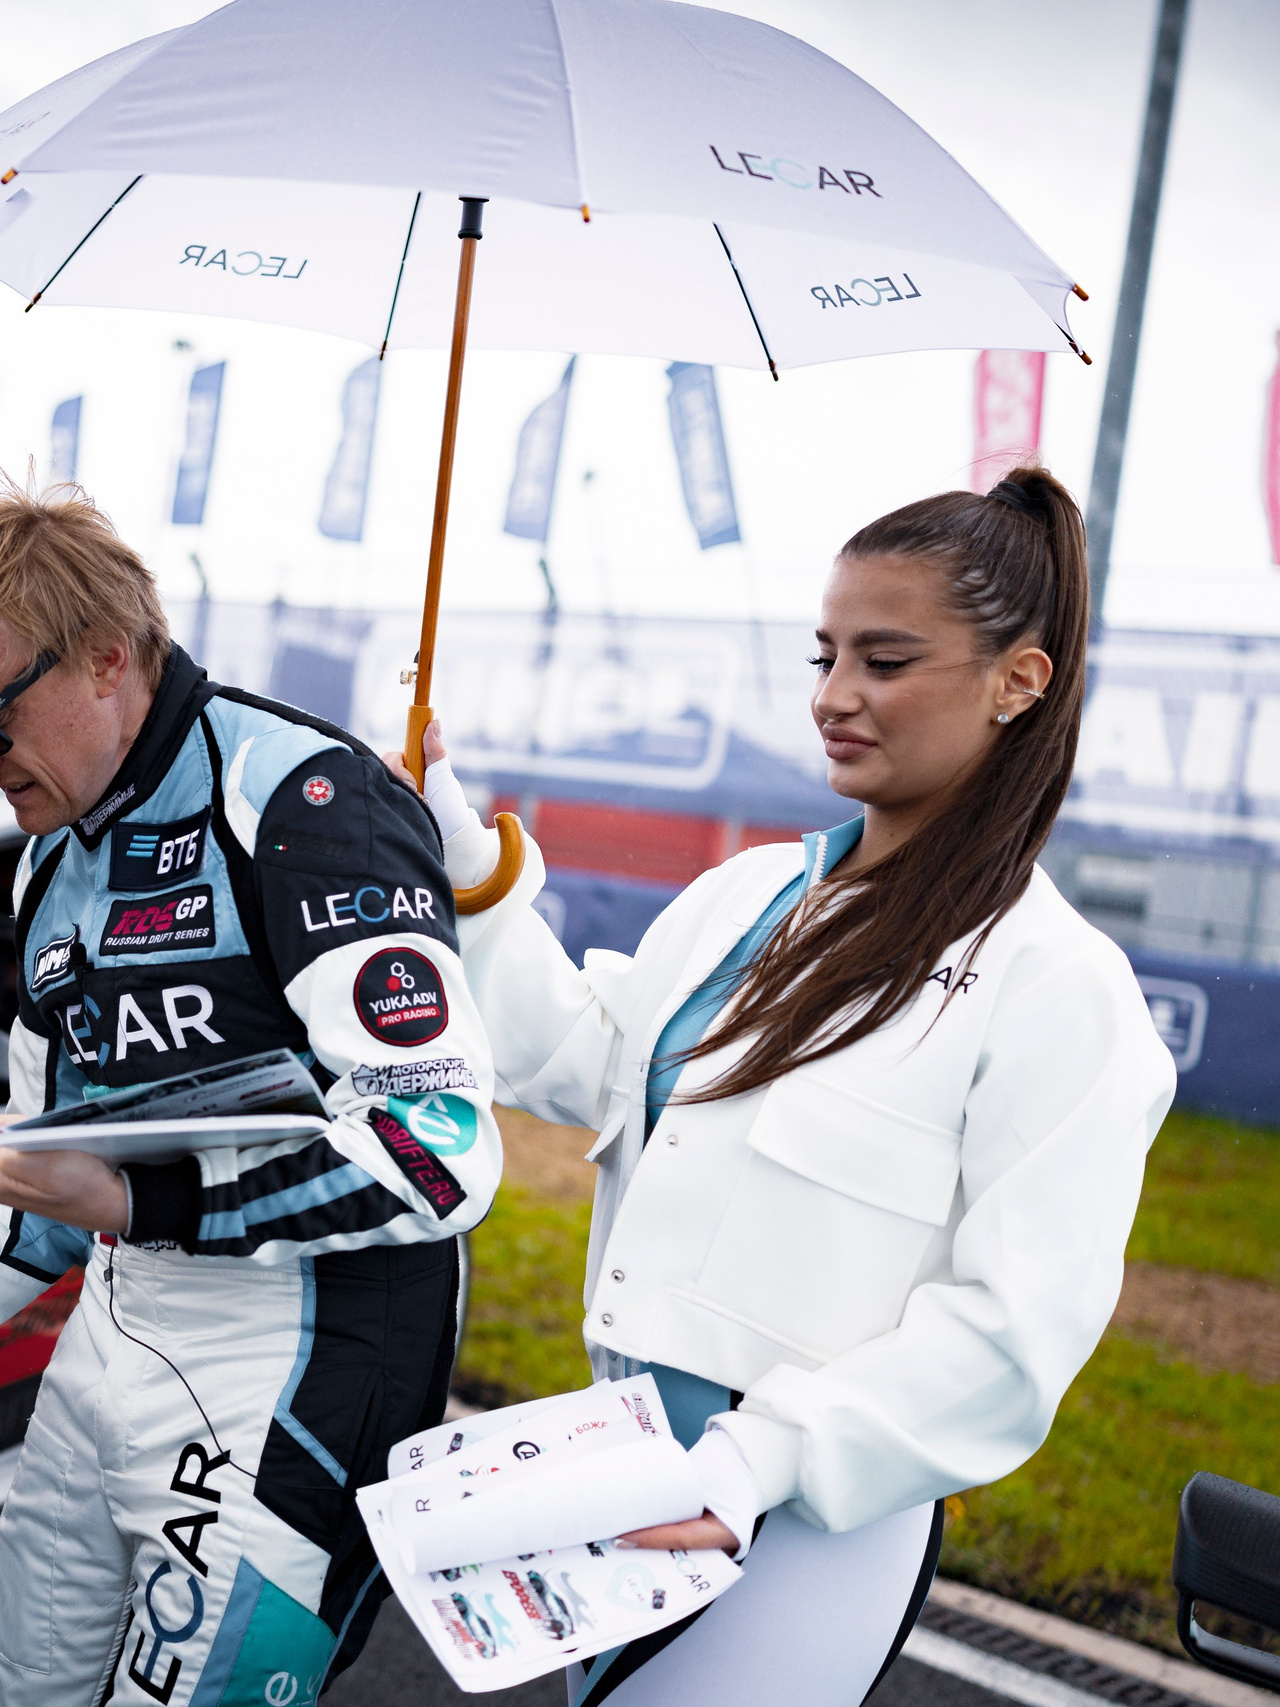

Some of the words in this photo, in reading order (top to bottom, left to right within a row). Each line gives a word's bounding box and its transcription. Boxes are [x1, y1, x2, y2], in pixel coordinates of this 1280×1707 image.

[709, 144, 883, 199] LECAR
[157, 828, 200, 875] ВТБ
[112, 901, 178, 935] RDS
[175, 896, 208, 920] GP
[300, 886, 436, 932] LECAR
[104, 936, 148, 946] RUSSIAN
[148, 932, 174, 945] DRIFT
[174, 927, 210, 940] SERIES
[369, 994, 411, 1014] YUKA
[412, 991, 437, 1006] ADV
[381, 1014, 402, 1026] PRO
[403, 1007, 437, 1021] RACING
[128, 1442, 231, 1706] ECAR
